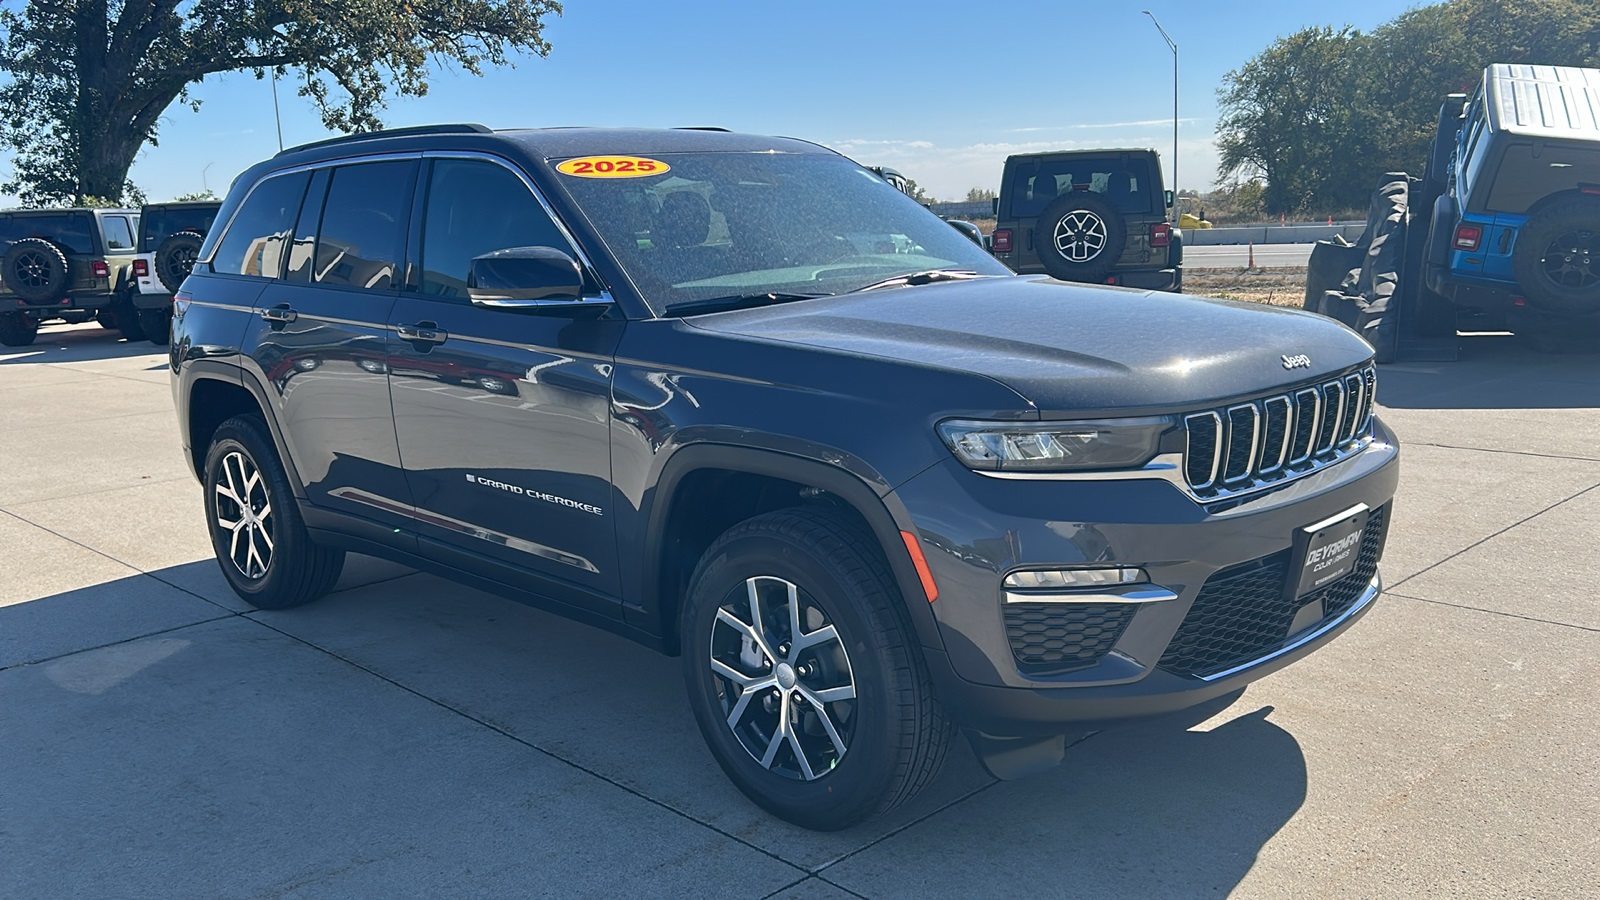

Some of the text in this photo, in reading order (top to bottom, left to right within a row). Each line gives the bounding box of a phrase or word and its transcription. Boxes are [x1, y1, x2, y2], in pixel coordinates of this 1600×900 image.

[573, 161, 657, 174] 2025
[1281, 354, 1311, 369] Jeep
[477, 476, 603, 516] GRAND CHEROKEE
[1305, 529, 1363, 567] DEYARMAN
